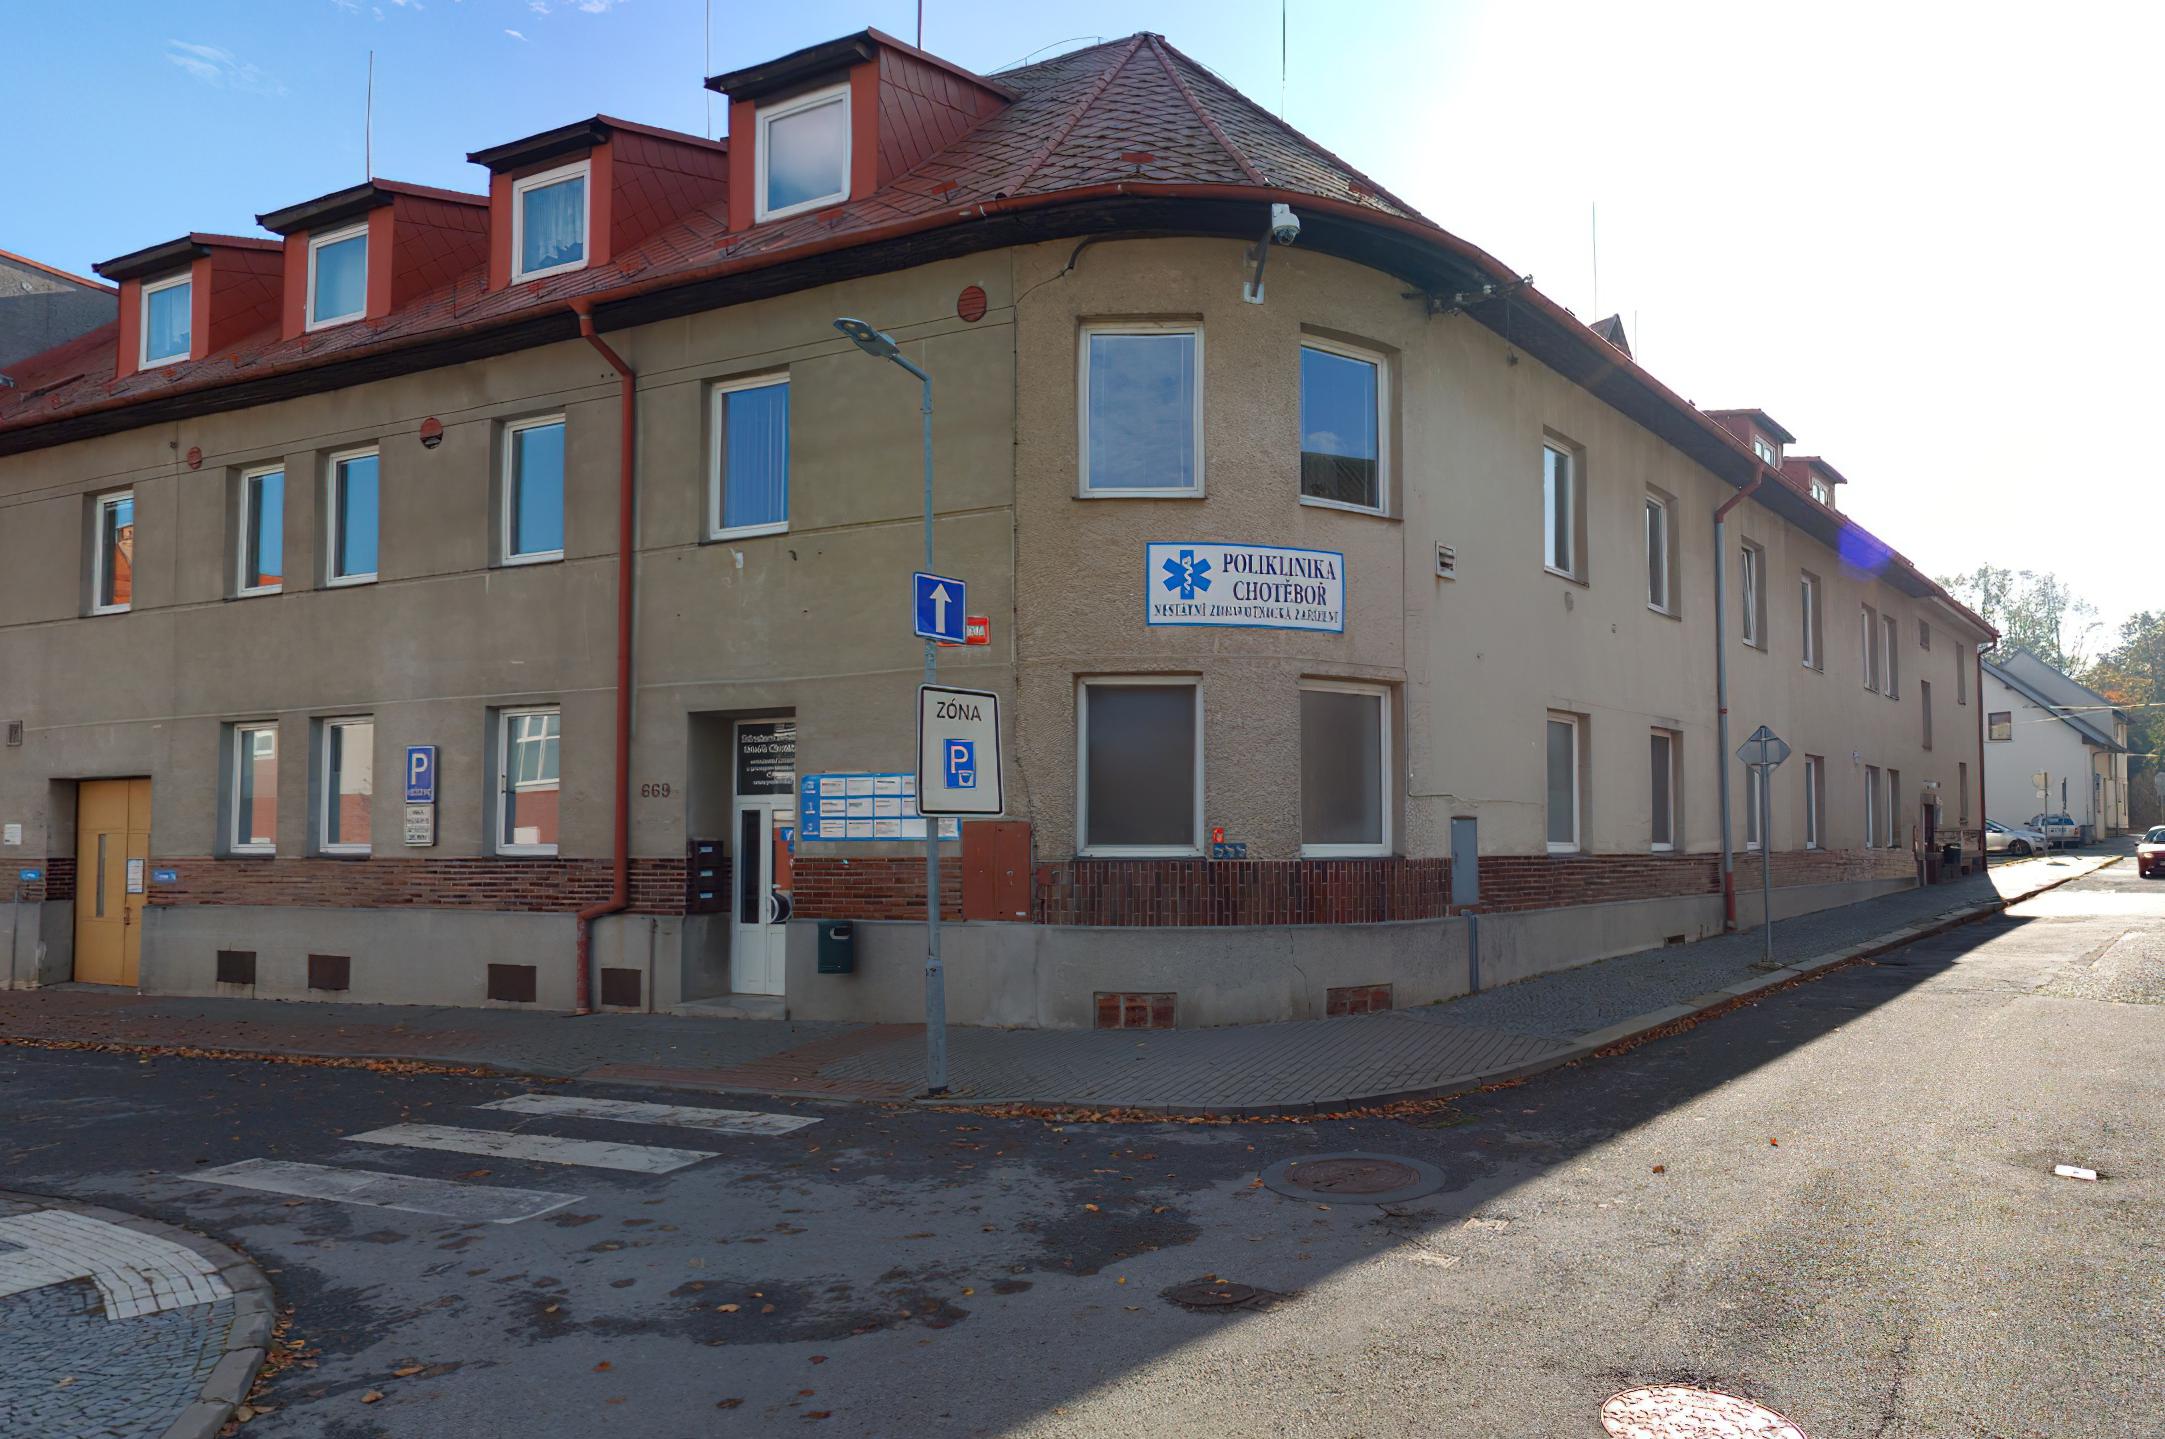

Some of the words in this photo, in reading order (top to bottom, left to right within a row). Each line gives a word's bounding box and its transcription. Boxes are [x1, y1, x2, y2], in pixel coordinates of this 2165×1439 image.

[1222, 553, 1336, 580] POLIKLINIKA
[1233, 579, 1327, 606] CHOTĚBOŘ
[937, 698, 982, 721] ZÓNA
[411, 753, 428, 784] P
[951, 745, 968, 773] P
[641, 783, 670, 798] 669
